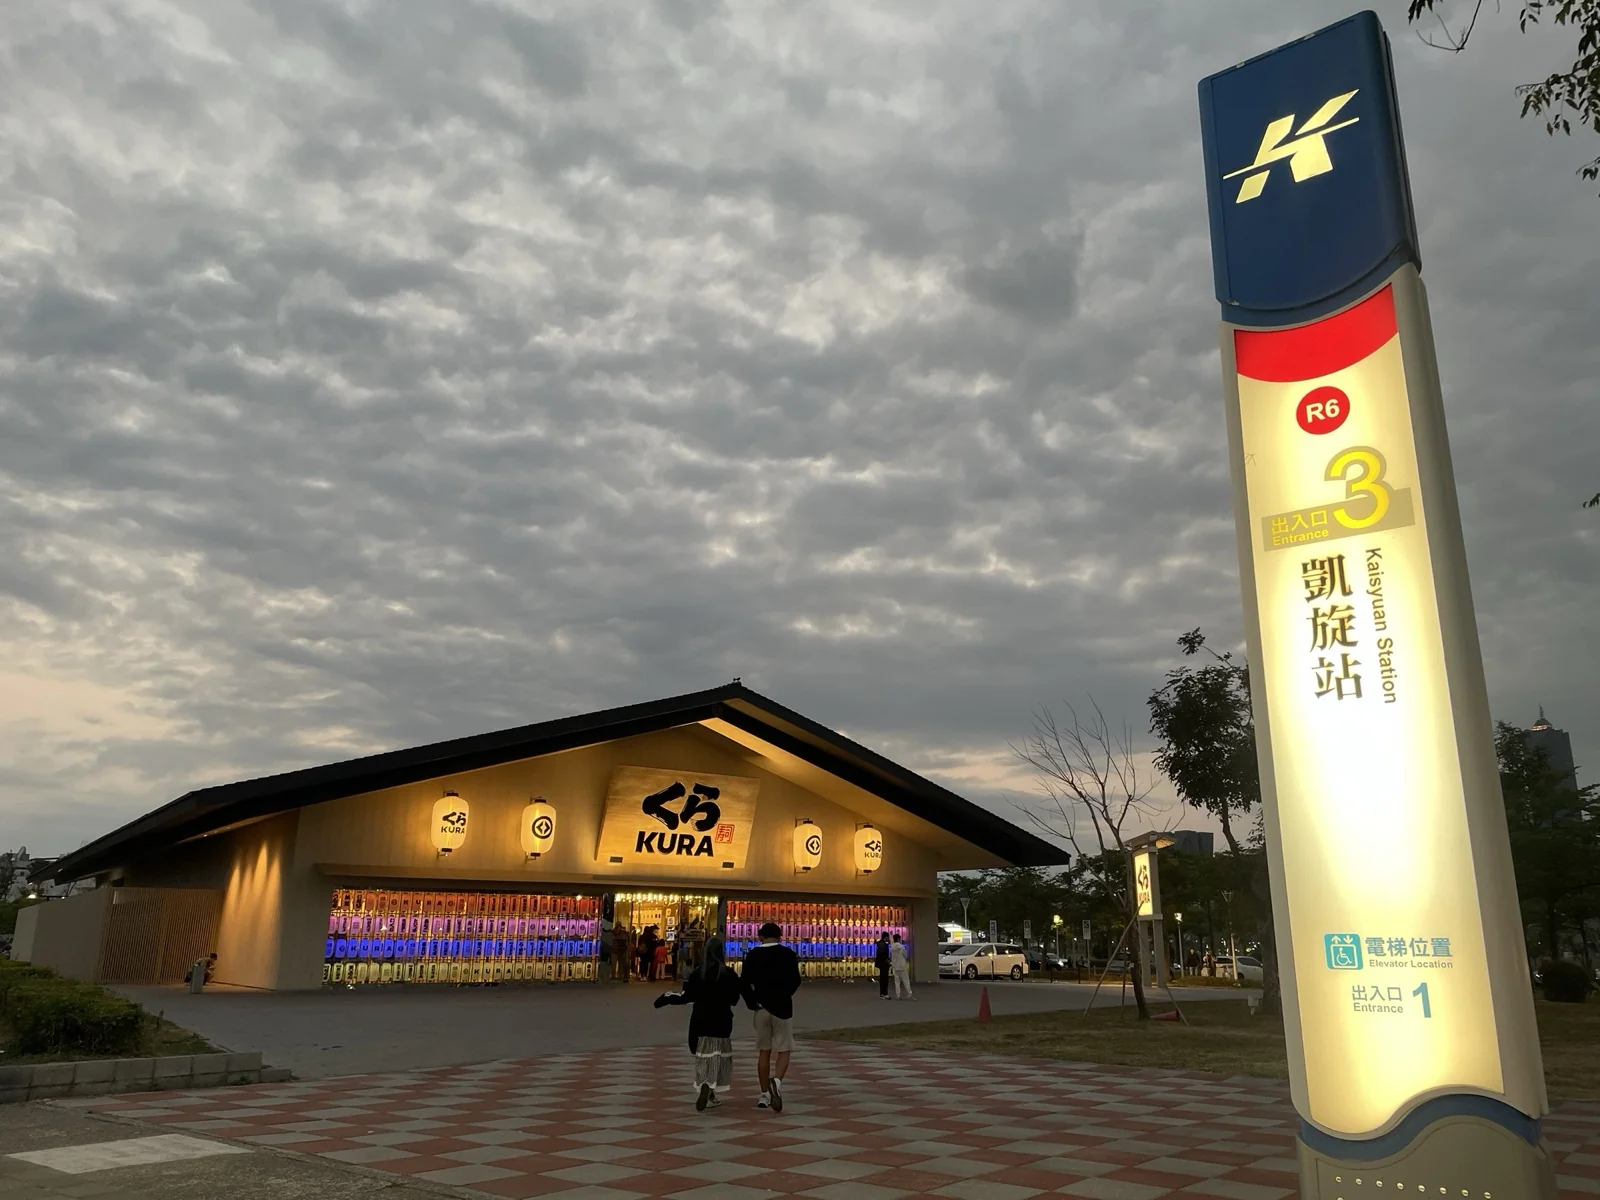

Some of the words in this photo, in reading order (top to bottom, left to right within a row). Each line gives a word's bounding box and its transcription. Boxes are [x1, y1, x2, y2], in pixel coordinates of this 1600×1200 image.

[1306, 399, 1340, 423] R6
[1327, 448, 1389, 528] 3
[1271, 510, 1328, 535] 出入口
[1272, 528, 1329, 546] Entrance
[1301, 554, 1363, 701] 凱旋站
[1366, 547, 1388, 632] Kaisyuan
[1377, 637, 1398, 704] Station
[442, 811, 466, 826] くら
[642, 781, 721, 832] くら
[441, 826, 465, 834] KURA
[635, 831, 714, 857] KURA
[1365, 937, 1453, 958] 電梯位置
[1369, 959, 1408, 968] Elevator
[1411, 960, 1453, 969] Location
[1352, 984, 1403, 1002] 出入口
[1412, 982, 1432, 1018] 1
[1353, 1002, 1404, 1014] Entrance
